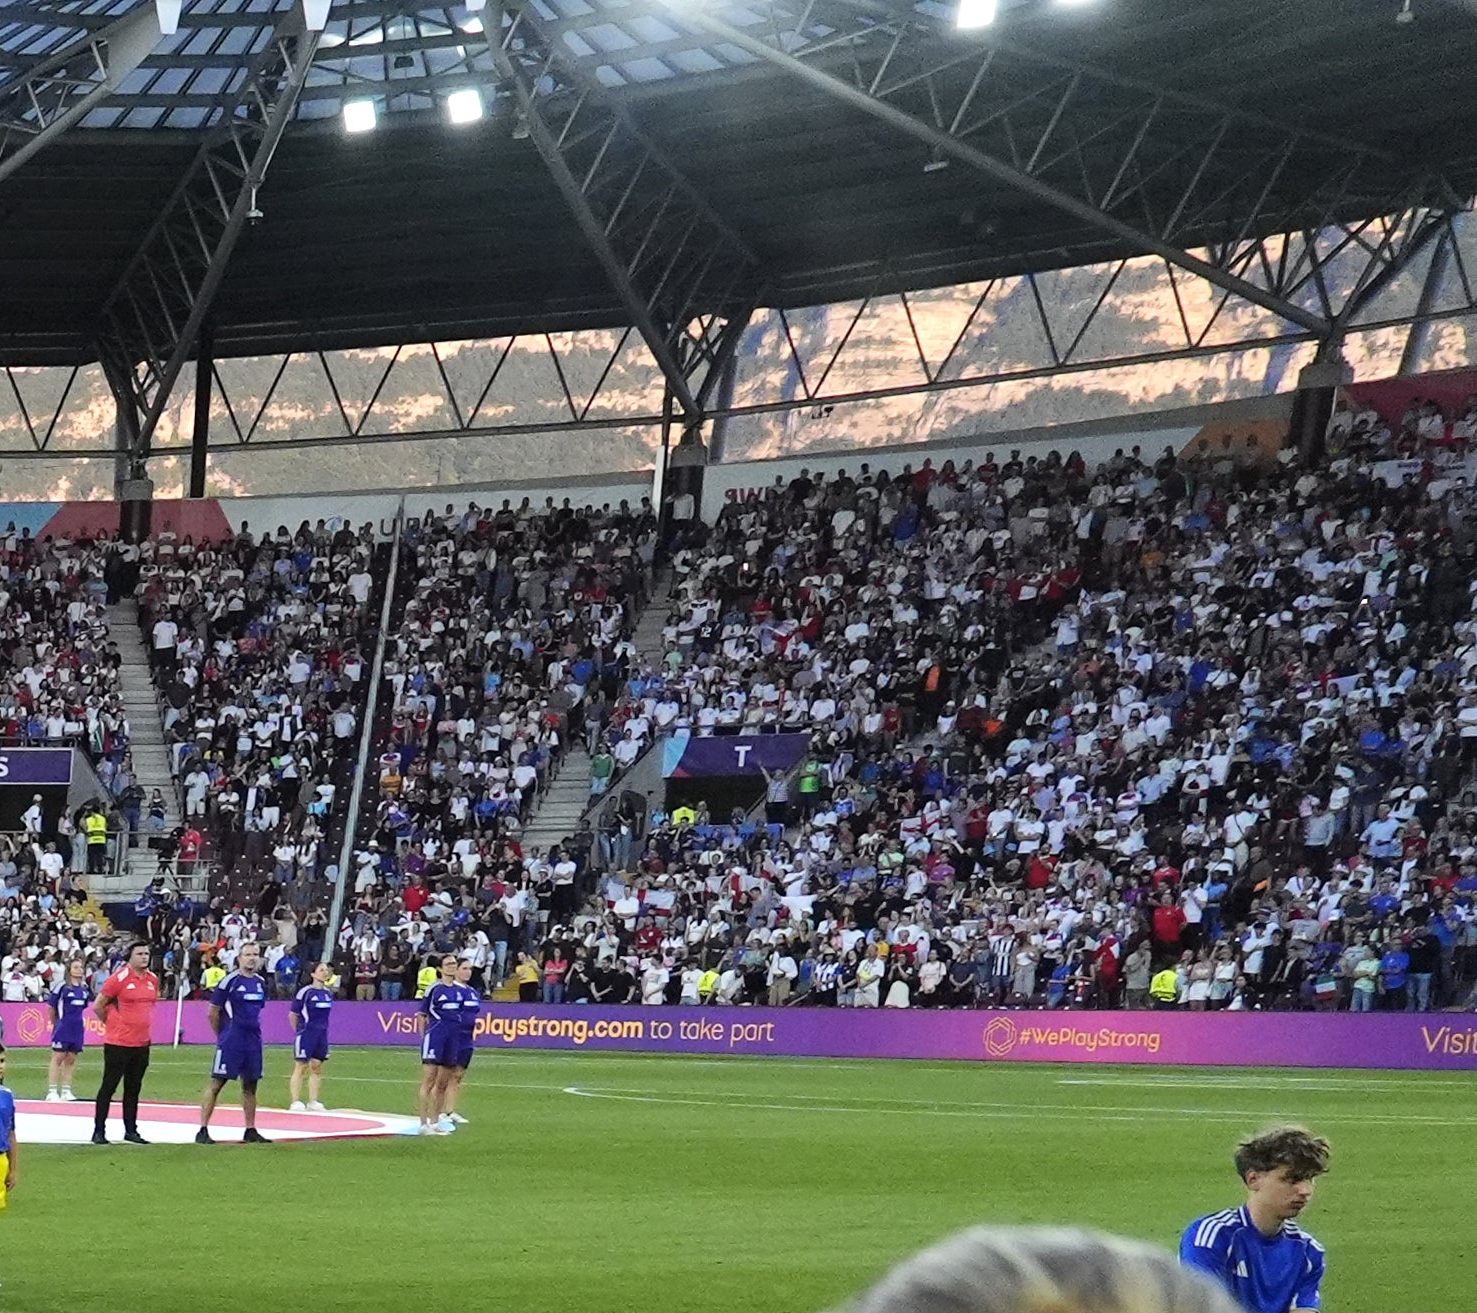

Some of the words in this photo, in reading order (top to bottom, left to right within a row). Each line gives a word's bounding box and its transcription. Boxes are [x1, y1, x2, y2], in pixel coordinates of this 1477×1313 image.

[734, 745, 752, 767] T
[377, 1011, 418, 1034] Visi
[473, 1012, 643, 1044] playstrong.com
[649, 1020, 672, 1039] to
[680, 1018, 724, 1041] take
[730, 1021, 775, 1047] part
[1019, 1027, 1162, 1053] #WePlayStrong
